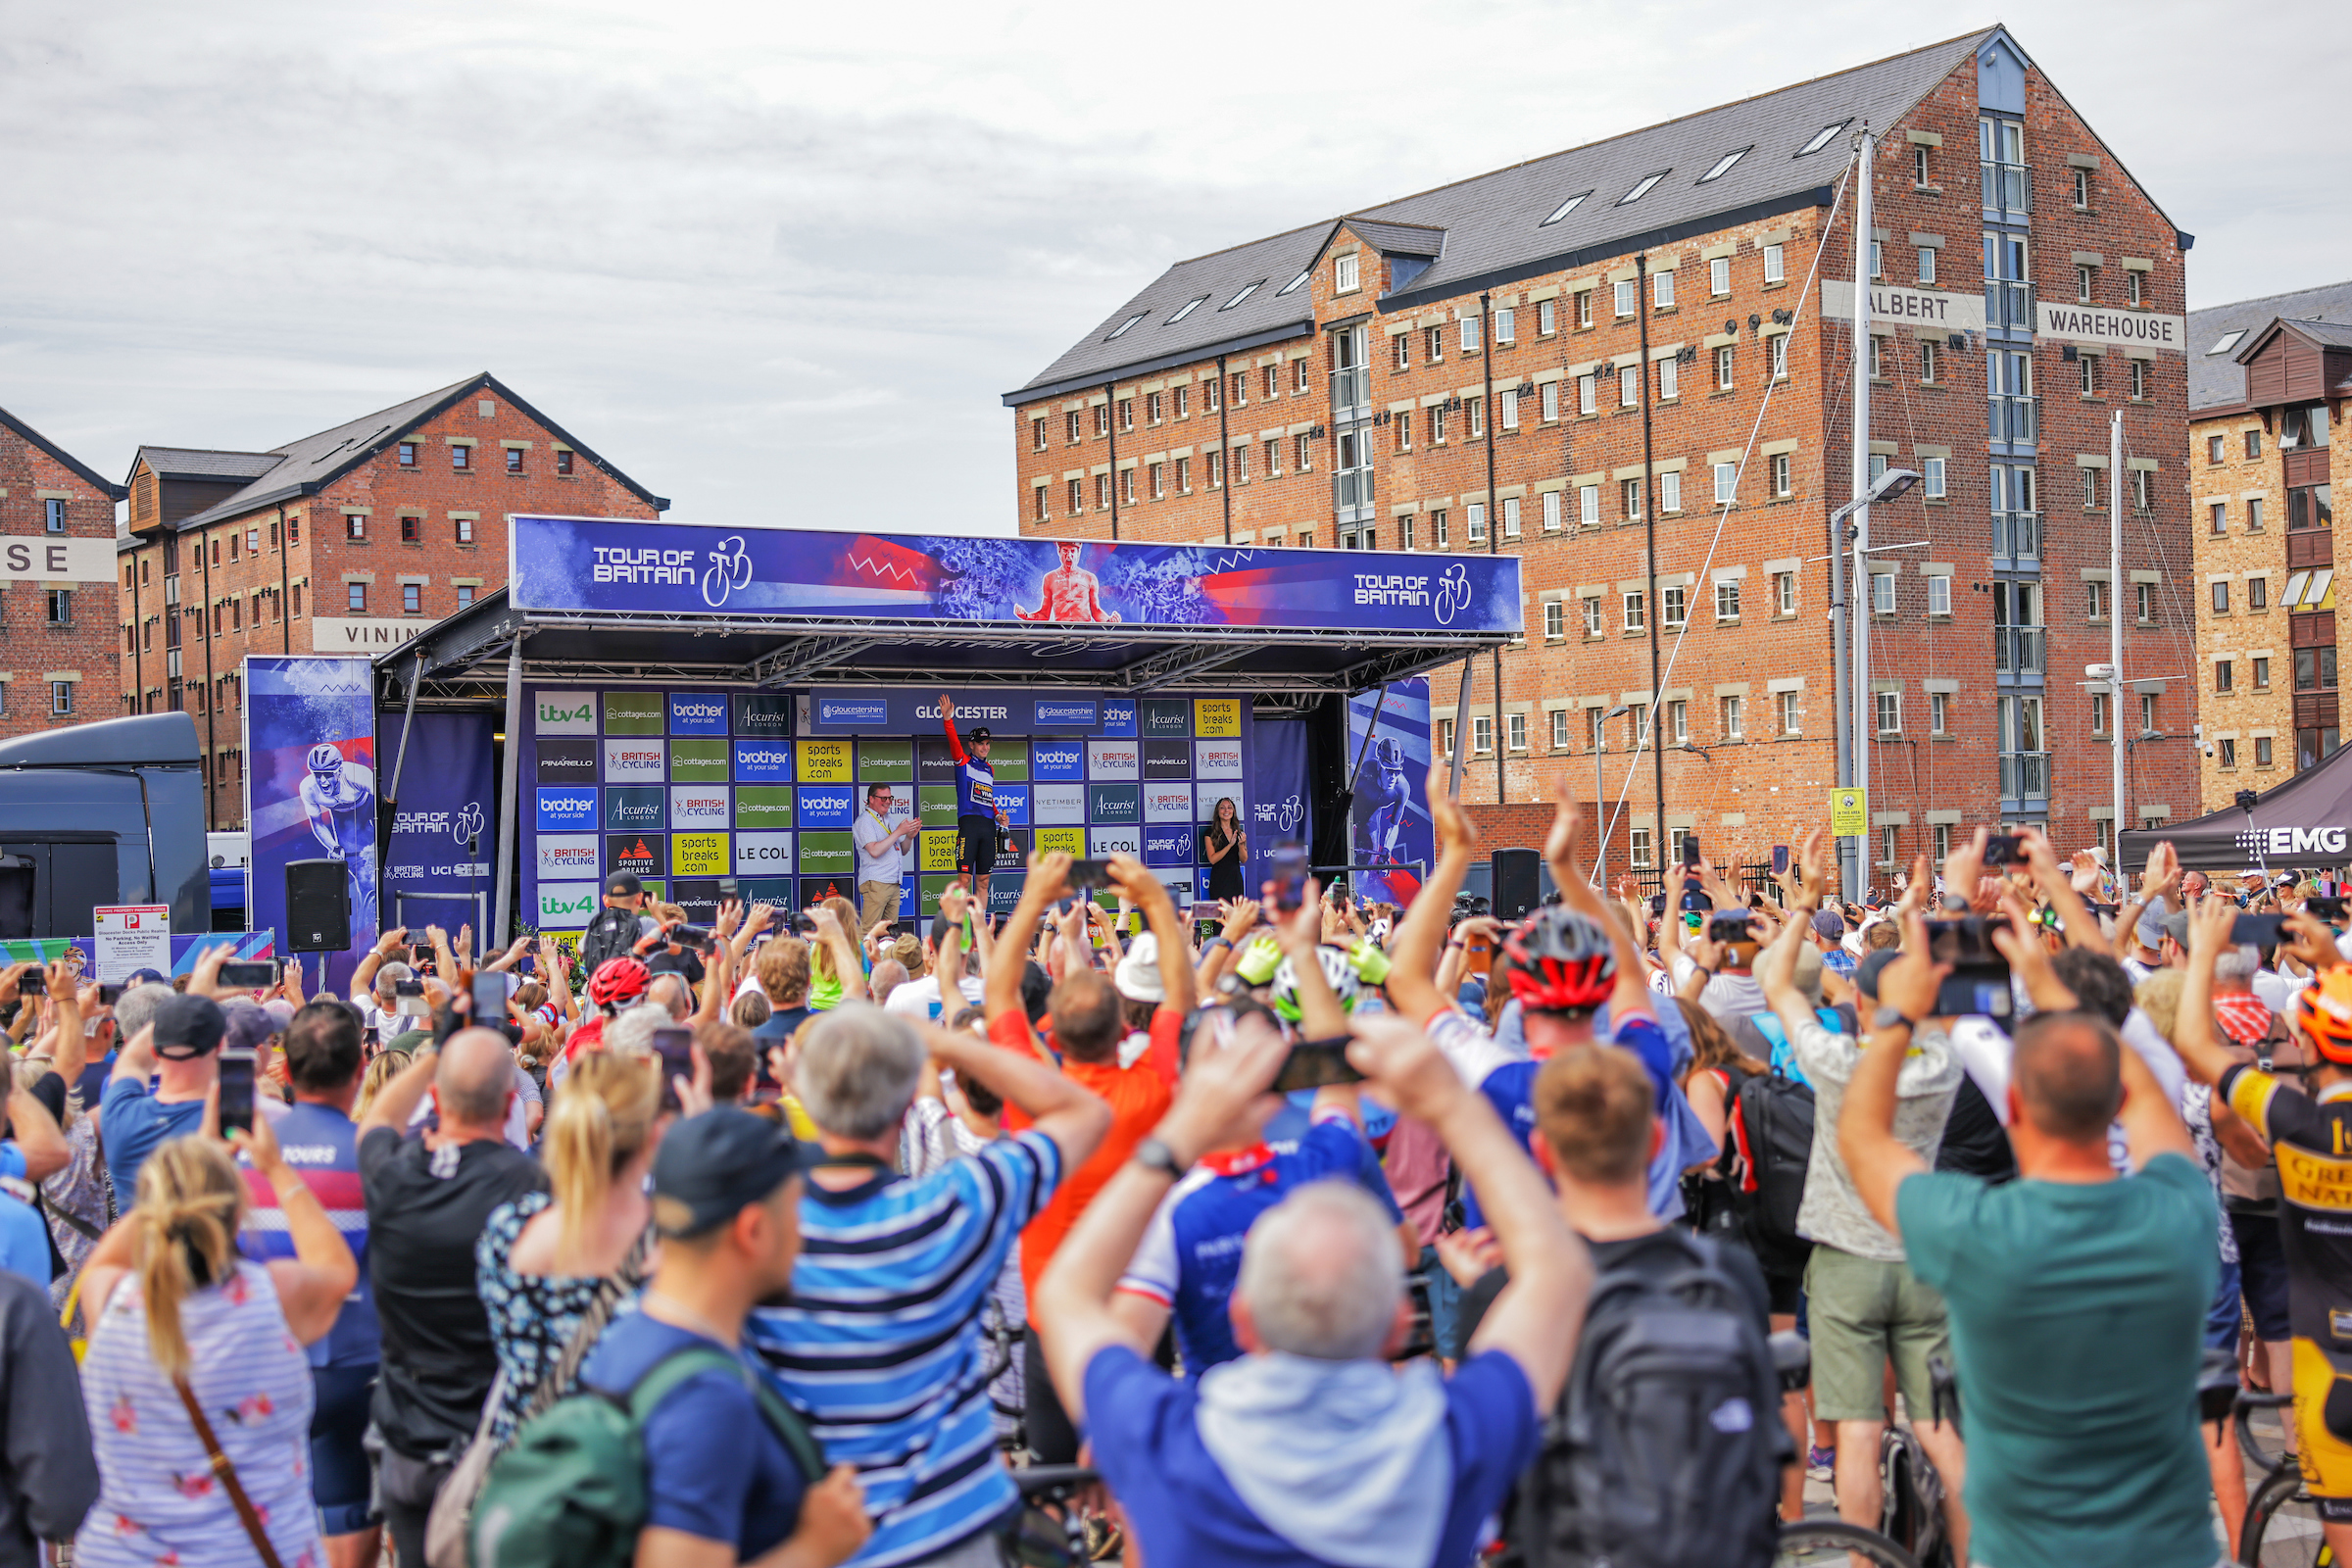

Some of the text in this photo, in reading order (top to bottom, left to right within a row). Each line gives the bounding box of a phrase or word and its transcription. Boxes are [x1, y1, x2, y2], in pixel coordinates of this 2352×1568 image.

[2049, 310, 2173, 341] WAREHOUSE
[593, 548, 695, 566] TOUR OF
[593, 564, 696, 585] BRITAIN
[1354, 573, 1428, 591] TOUR OF
[1354, 588, 1430, 607] BRITAIN
[540, 705, 592, 722] itv4
[673, 704, 723, 716] brother
[831, 706, 883, 715] Gloucestershire
[915, 706, 1007, 718] GLOCESTER
[1047, 708, 1093, 716] Gloucestershire
[1202, 703, 1231, 712] sports
[617, 710, 661, 719] cottages.com
[739, 704, 784, 726] Accurist
[1103, 709, 1133, 720] other
[1147, 708, 1185, 729] Accurist
[1203, 714, 1233, 724] breaks
[1203, 725, 1223, 734] .com
[622, 752, 661, 760] BRITISH
[738, 751, 788, 763] brother
[808, 745, 840, 757] sports
[1036, 751, 1079, 763] brother
[684, 758, 726, 766] cottages.com
[808, 758, 842, 767] breaks
[988, 759, 1026, 767] cottages.com
[808, 769, 832, 778] .com
[541, 798, 594, 811] brother
[801, 797, 850, 809] brother
[993, 795, 1025, 807] other
[1095, 794, 1135, 814] Accurist
[612, 797, 660, 821] Accurist
[395, 812, 449, 821] OUR OF
[1254, 812, 1277, 821] TAIN
[392, 822, 449, 833] BRITAIN
[681, 837, 716, 849] sports
[1044, 832, 1073, 843] sports
[2269, 827, 2347, 854] EMG
[1045, 844, 1075, 854] breaks
[1093, 841, 1137, 853] LE COL
[682, 850, 718, 860] breaks
[739, 848, 789, 859] LE COL
[811, 850, 852, 858] cottages.com
[431, 866, 451, 875] UCI
[682, 863, 708, 872] .com
[988, 883, 1025, 905] Accurist
[542, 896, 595, 914] itv4
[127, 914, 138, 928] P
[282, 1145, 337, 1164] TOURS
